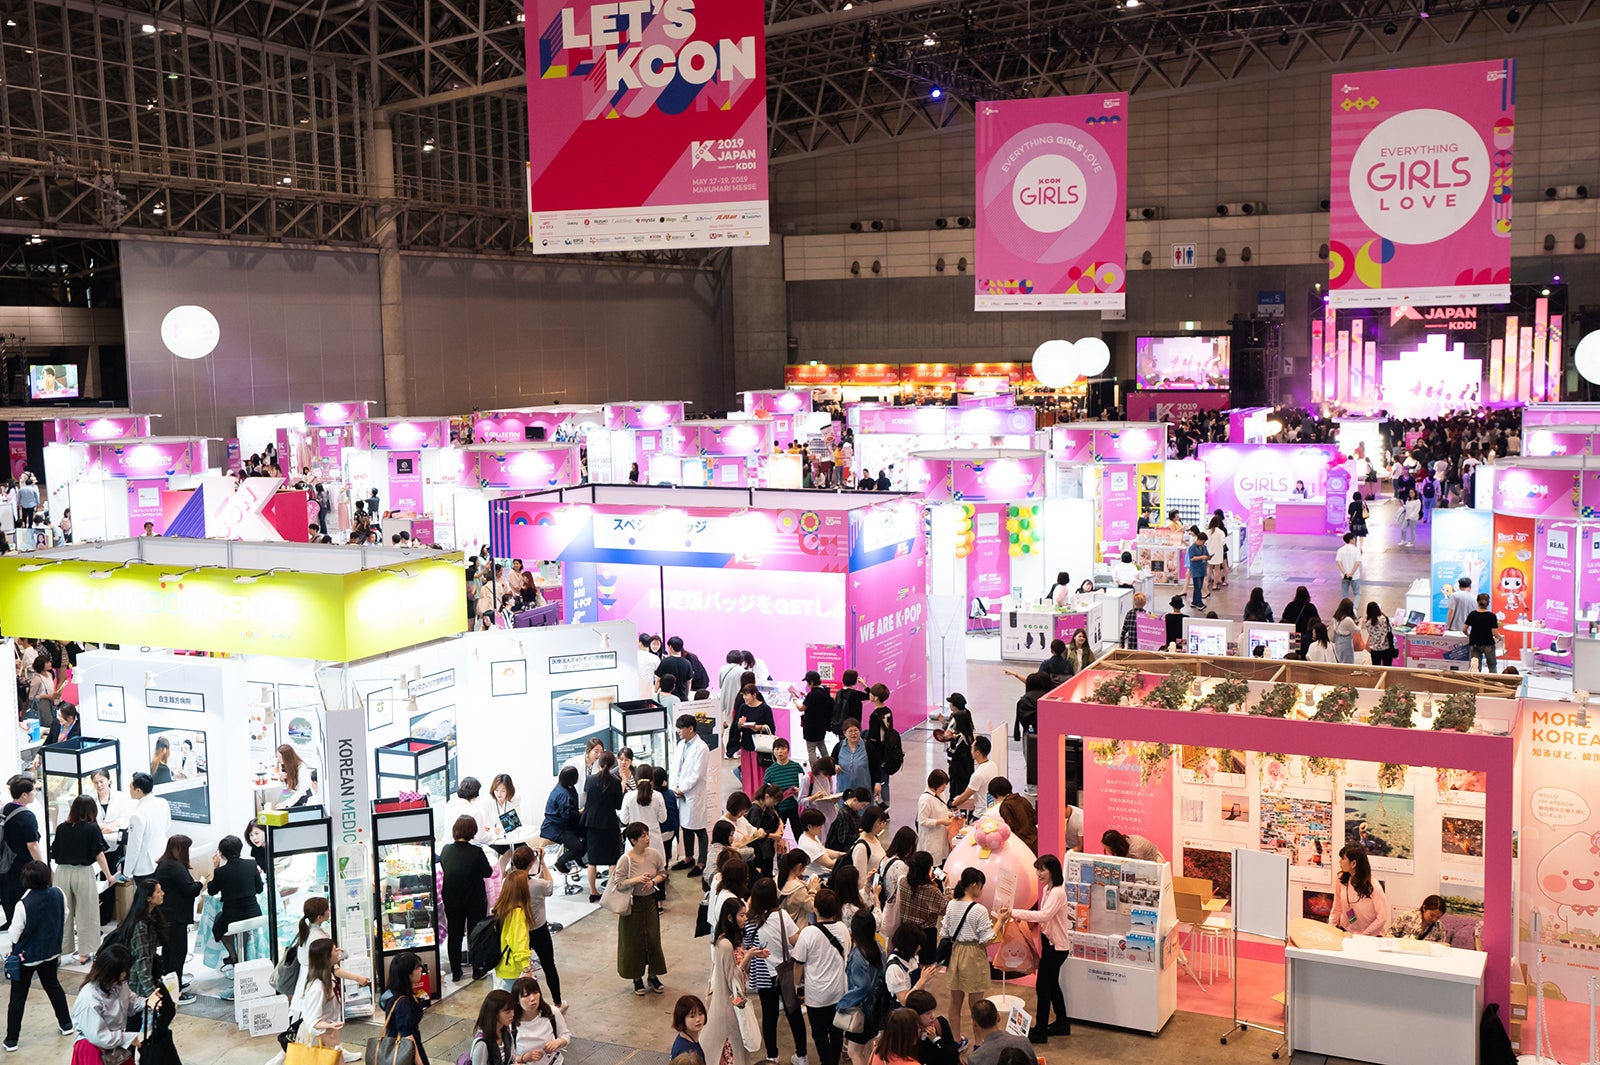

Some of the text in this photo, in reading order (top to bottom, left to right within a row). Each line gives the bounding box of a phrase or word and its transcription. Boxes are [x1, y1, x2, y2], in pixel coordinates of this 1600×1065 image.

[561, 0, 697, 49] LET'S
[605, 36, 756, 91] KCON
[717, 138, 745, 149] 2019
[1381, 143, 1458, 158] EVERYTHING
[717, 149, 756, 161] JAPAN
[1001, 135, 1103, 174] EVERYTHING GIRLS LOVE
[735, 162, 757, 170] KDDI
[1367, 156, 1471, 192] GIRLS
[692, 183, 757, 193] MAKUHARI MESSE
[1019, 185, 1079, 206] GIRLS
[1380, 194, 1456, 211] LOVE
[1424, 307, 1477, 319] JAPAN
[1448, 321, 1477, 330] KDDI
[1177, 403, 1198, 411] 2019
[1240, 477, 1288, 492] GIRLS
[1549, 541, 1566, 550] REAL
[859, 622, 875, 644] WE
[876, 614, 895, 637] ARE
[1532, 711, 1592, 729] MORE
[1532, 728, 1600, 747] KOREA
[338, 738, 355, 797] KOREAN
